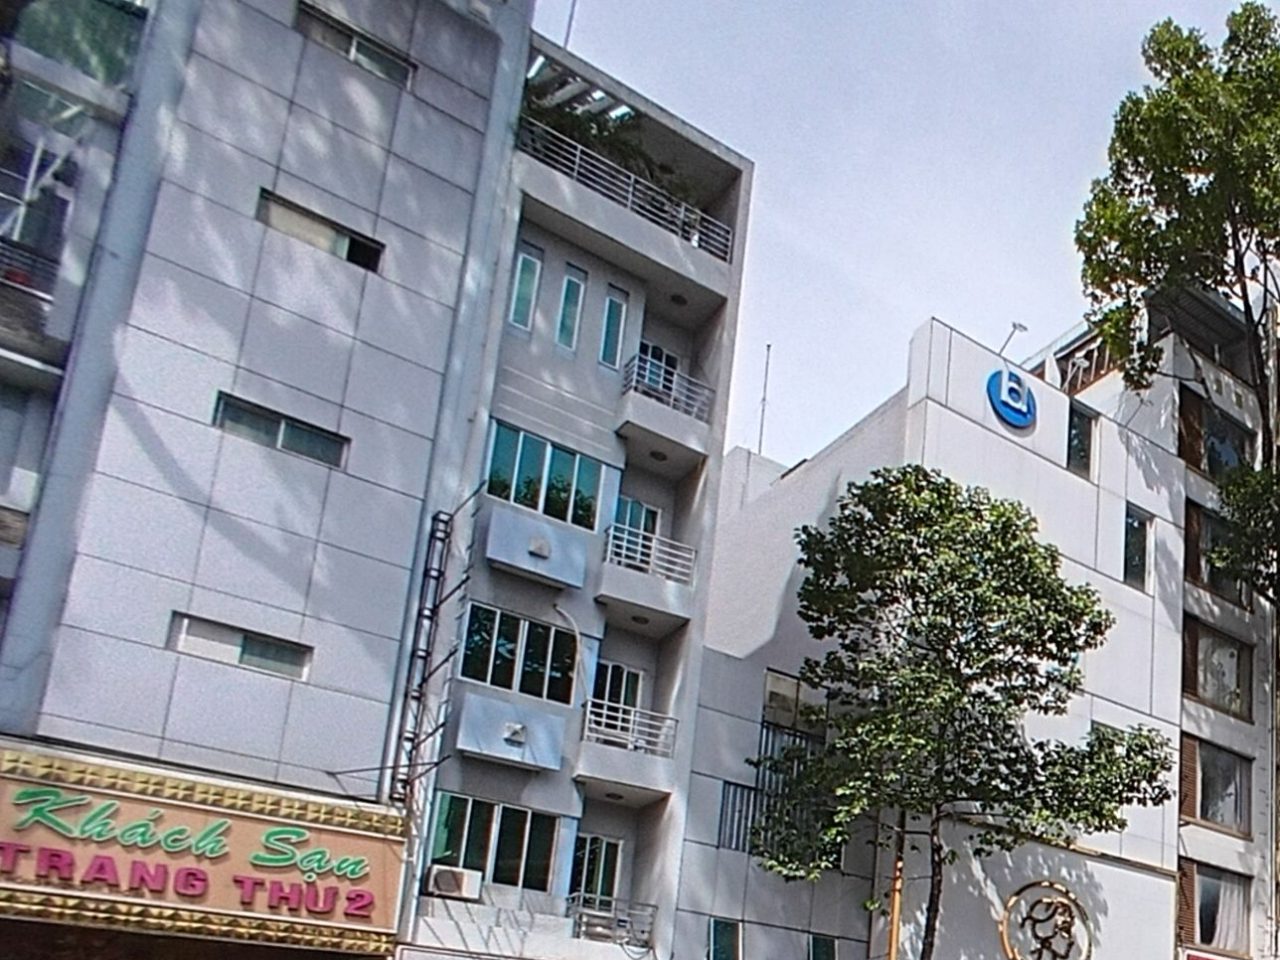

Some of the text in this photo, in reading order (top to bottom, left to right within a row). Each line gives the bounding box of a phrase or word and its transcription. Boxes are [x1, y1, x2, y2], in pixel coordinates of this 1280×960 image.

[0, 841, 208, 897] TRANG
[12, 787, 370, 882] Khách Sạn
